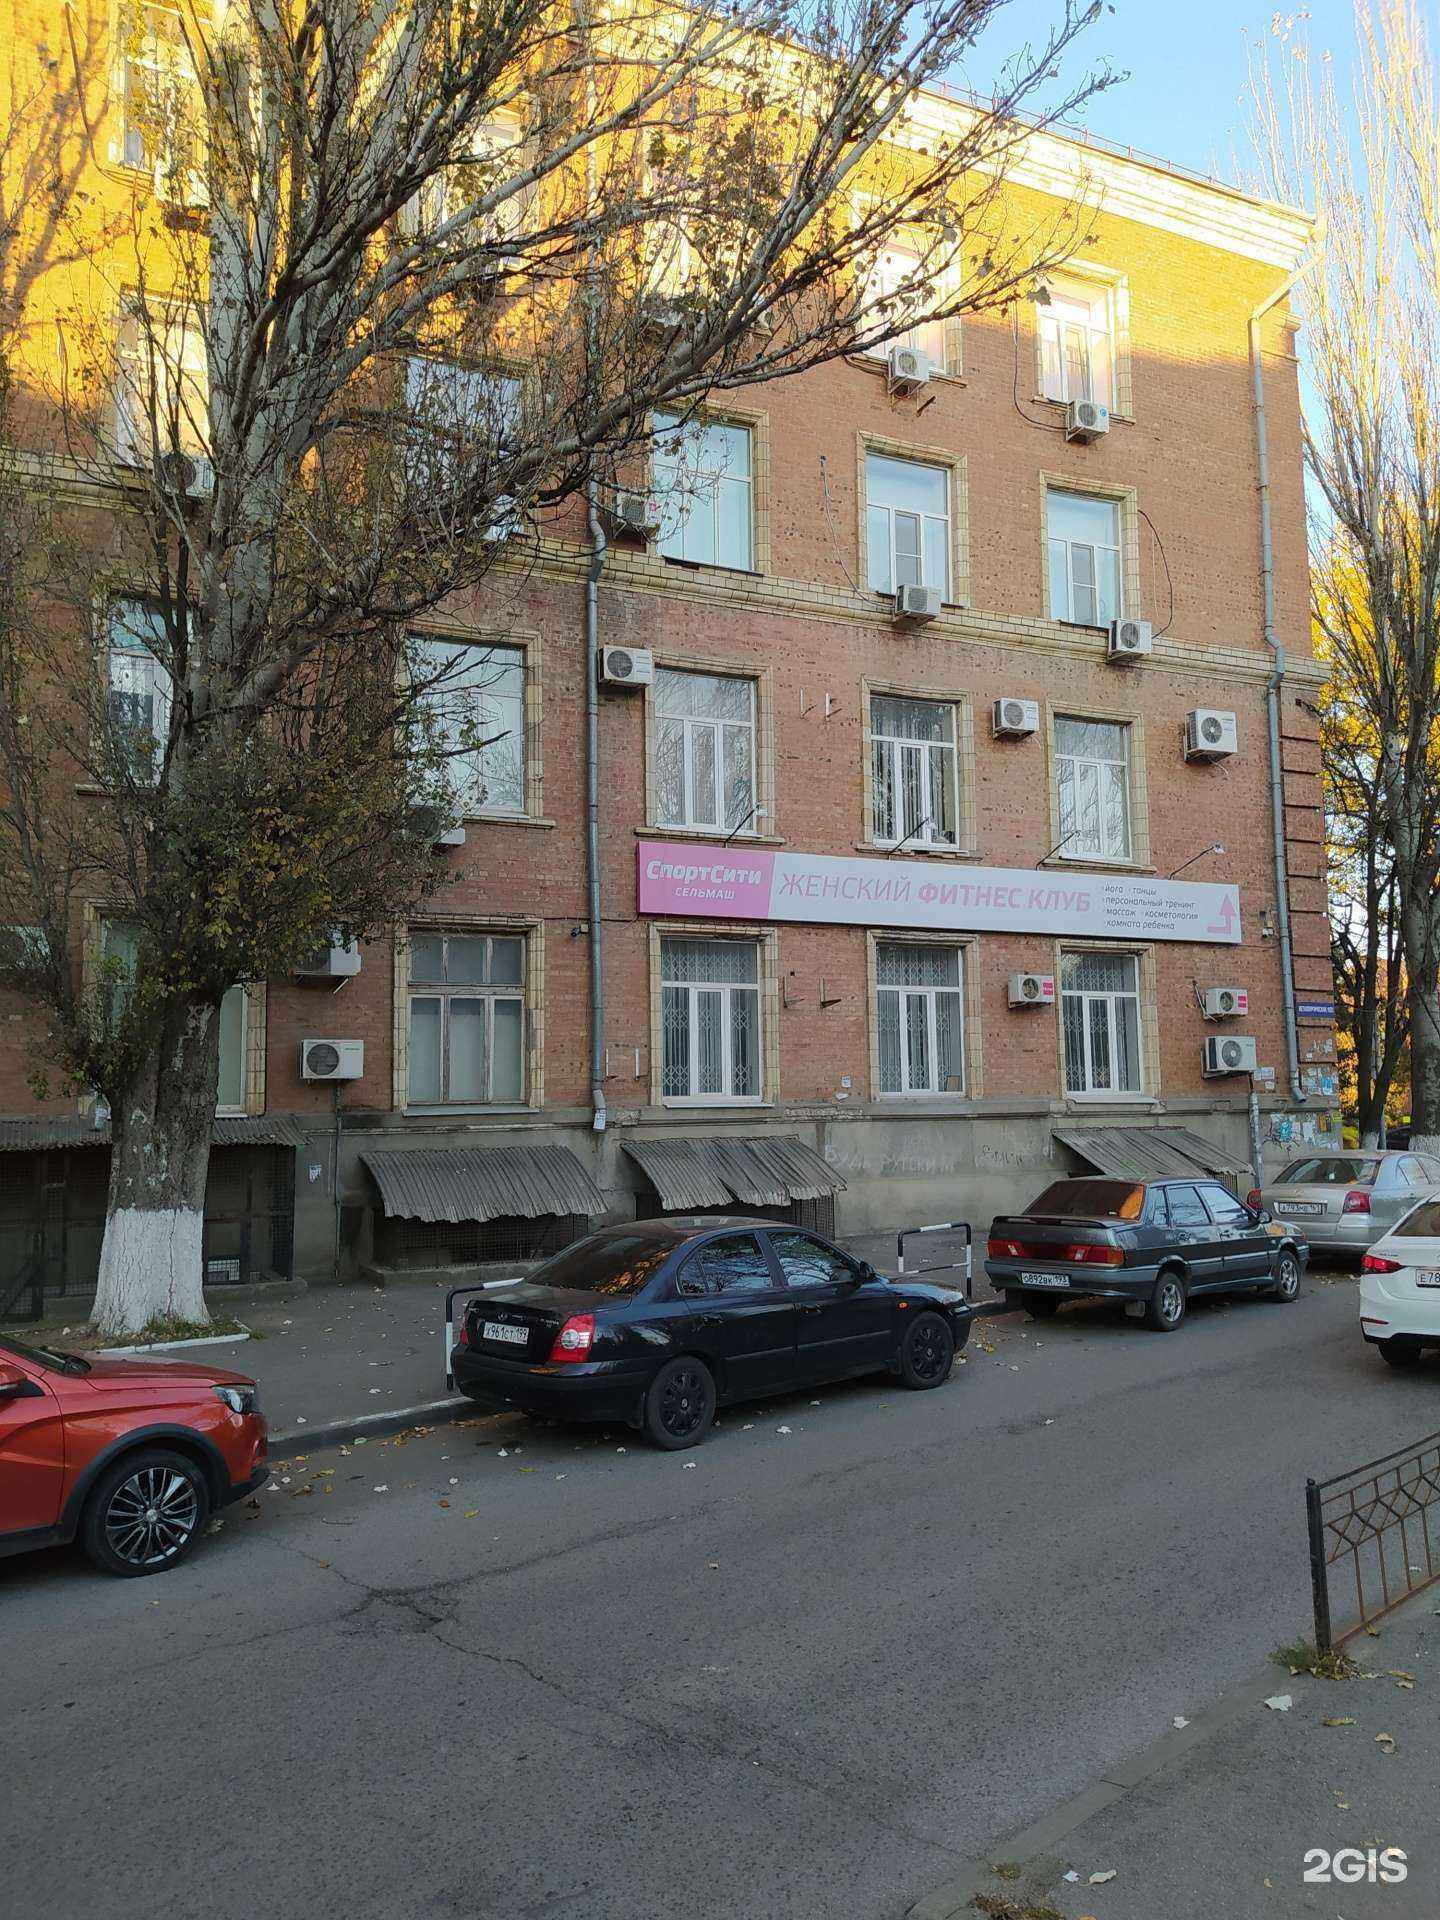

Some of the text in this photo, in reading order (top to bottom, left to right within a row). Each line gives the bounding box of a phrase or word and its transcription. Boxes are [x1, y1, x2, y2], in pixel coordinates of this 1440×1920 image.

[646, 860, 762, 884] СпортСити
[674, 887, 735, 900] СЕЛЬМАШ
[779, 873, 1091, 912] ЖЕНСКИЙ ФИТНЕС КЛУБ
[1105, 896, 1163, 907] персональный
[1106, 908, 1199, 920] массаж косметология
[1106, 919, 1141, 929] комната
